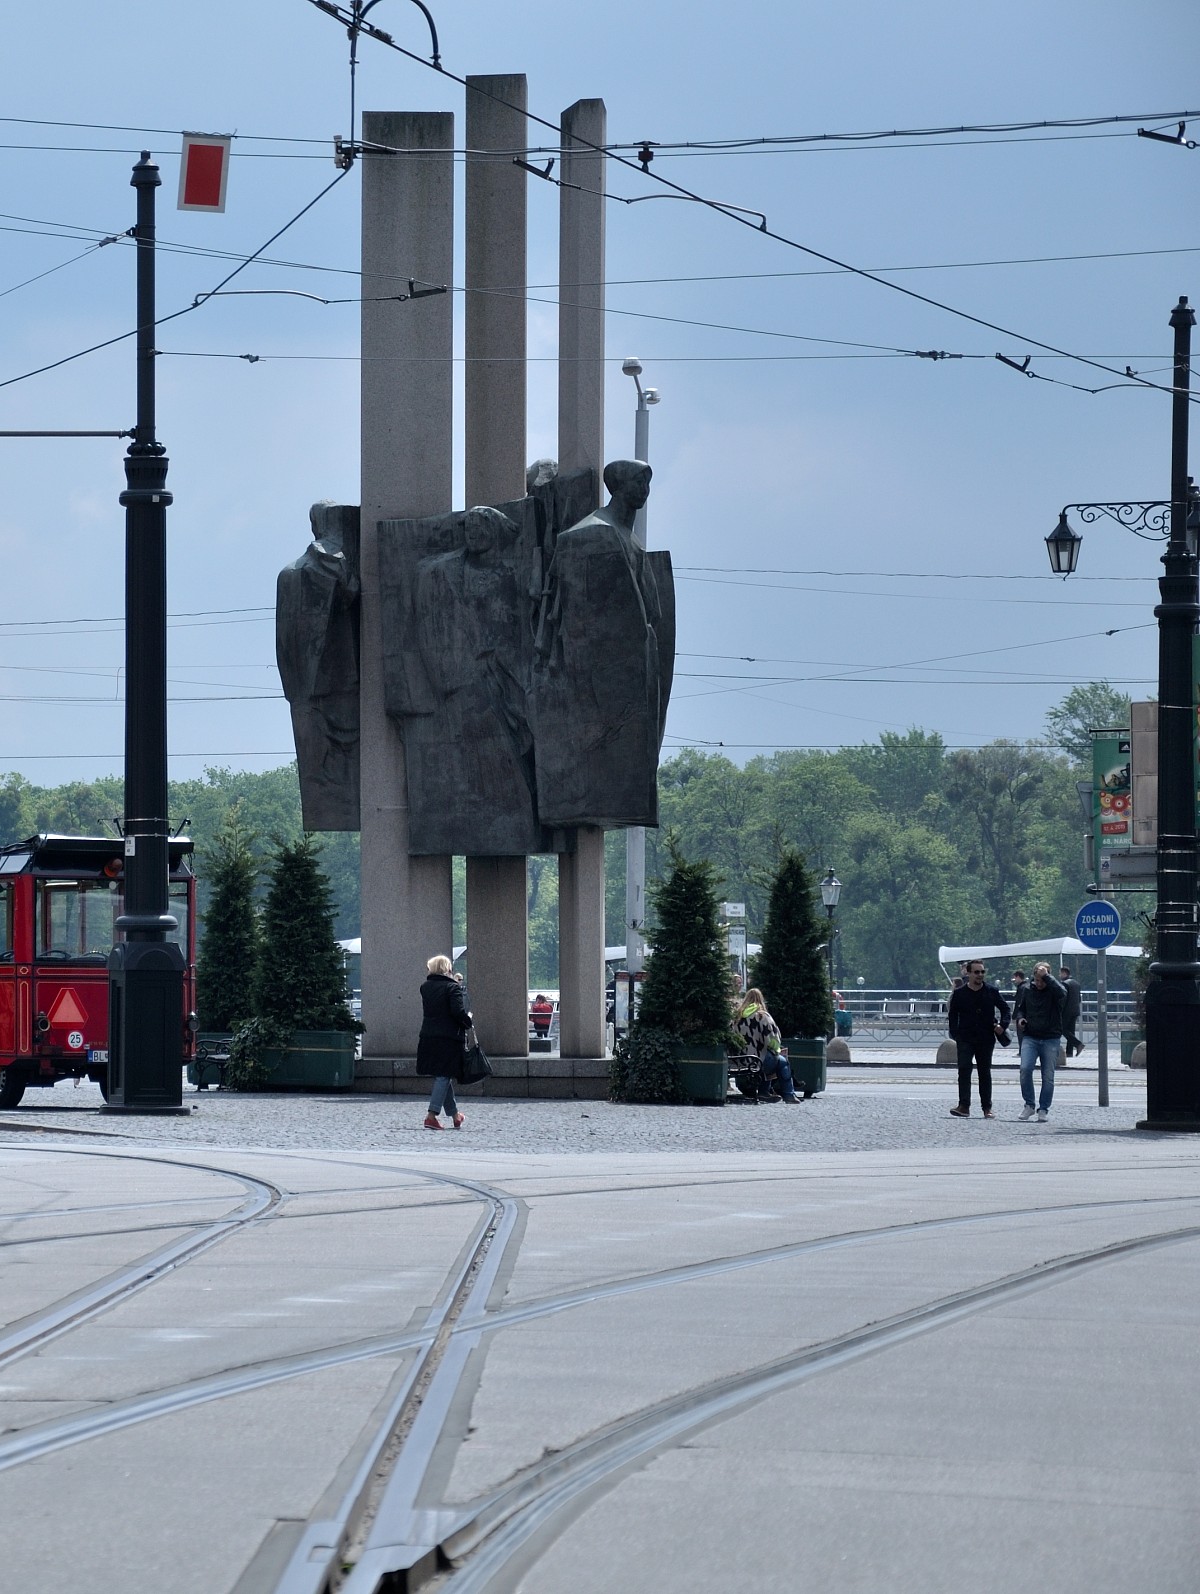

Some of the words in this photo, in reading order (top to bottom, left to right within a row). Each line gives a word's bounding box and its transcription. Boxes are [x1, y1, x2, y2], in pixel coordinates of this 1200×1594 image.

[1081, 914, 1114, 924] ZOSADNI
[1079, 927, 1085, 936] Z
[1086, 926, 1116, 936] BICYKLA
[70, 1034, 81, 1043] 25
